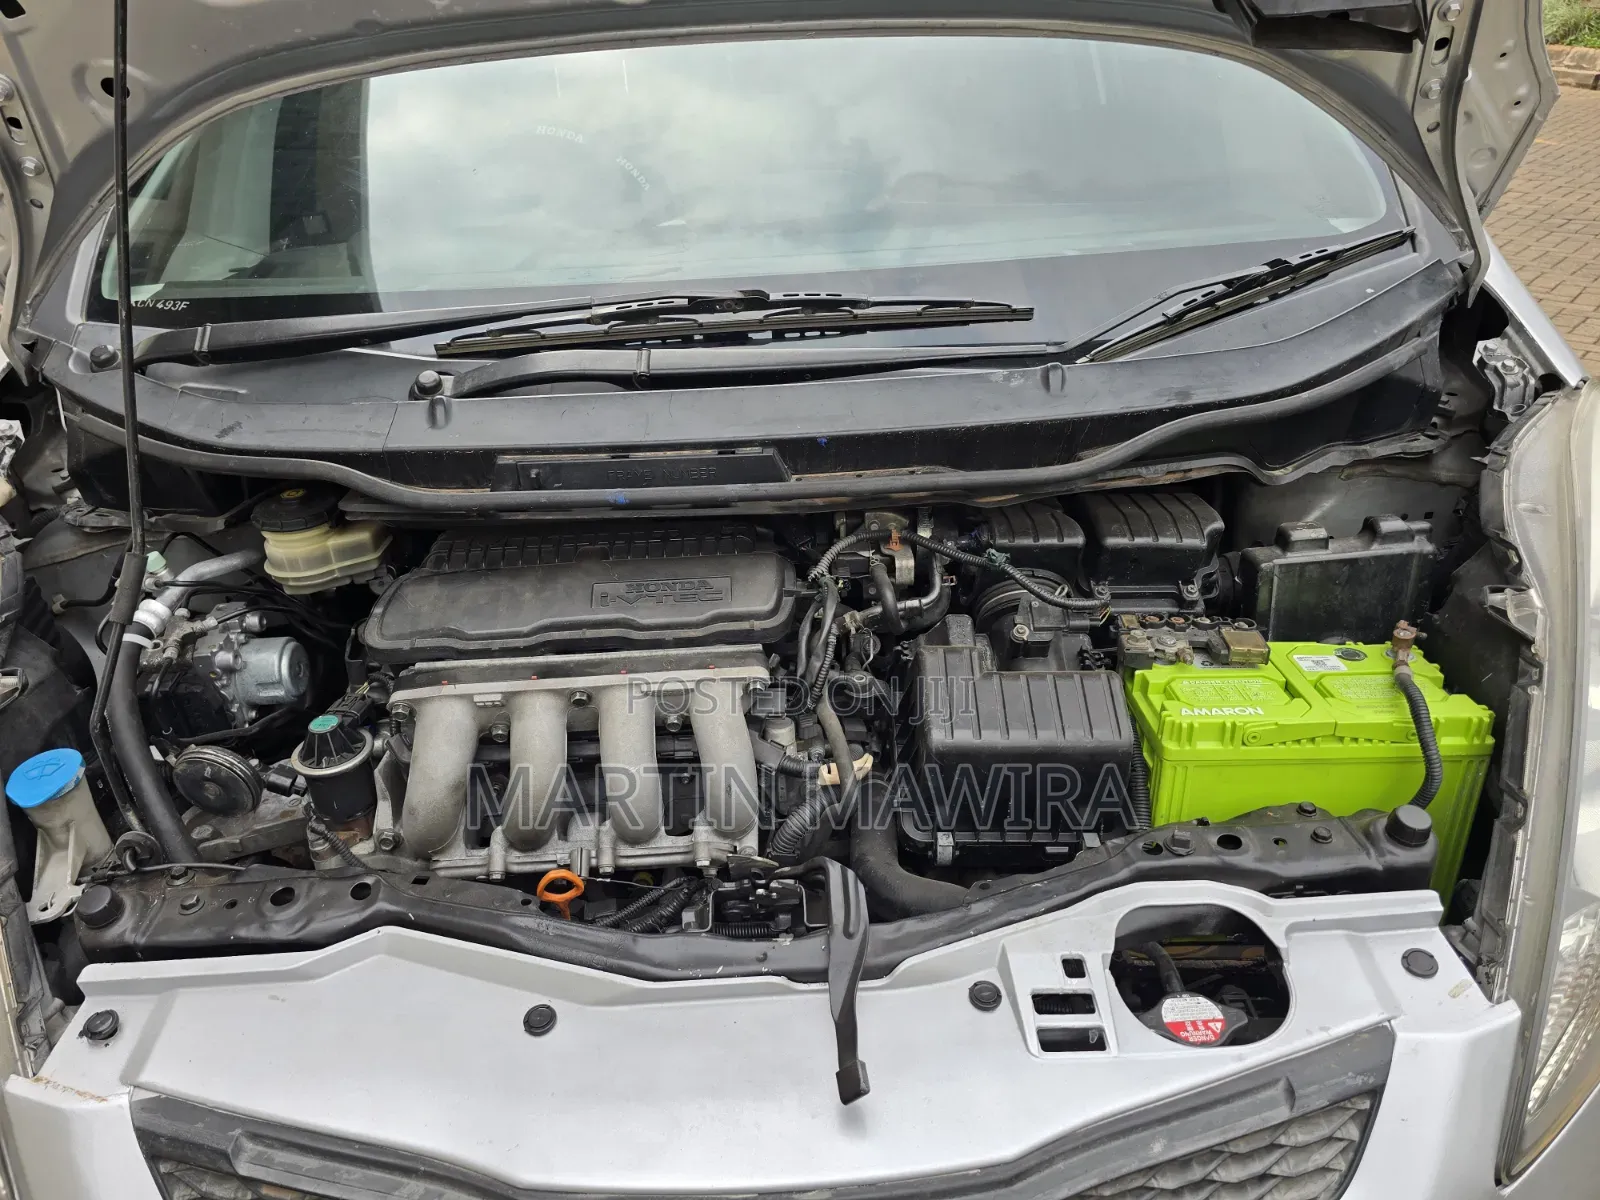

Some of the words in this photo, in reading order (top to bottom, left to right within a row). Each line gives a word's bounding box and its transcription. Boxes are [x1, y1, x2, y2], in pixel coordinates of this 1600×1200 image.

[536, 125, 584, 143] HONDA
[616, 155, 650, 191] HONDA
[156, 300, 190, 311] 493F
[607, 468, 653, 480] FRAME
[662, 467, 717, 479] NUMBER
[625, 580, 714, 593] HONDA
[1181, 706, 1264, 716] AMARON
